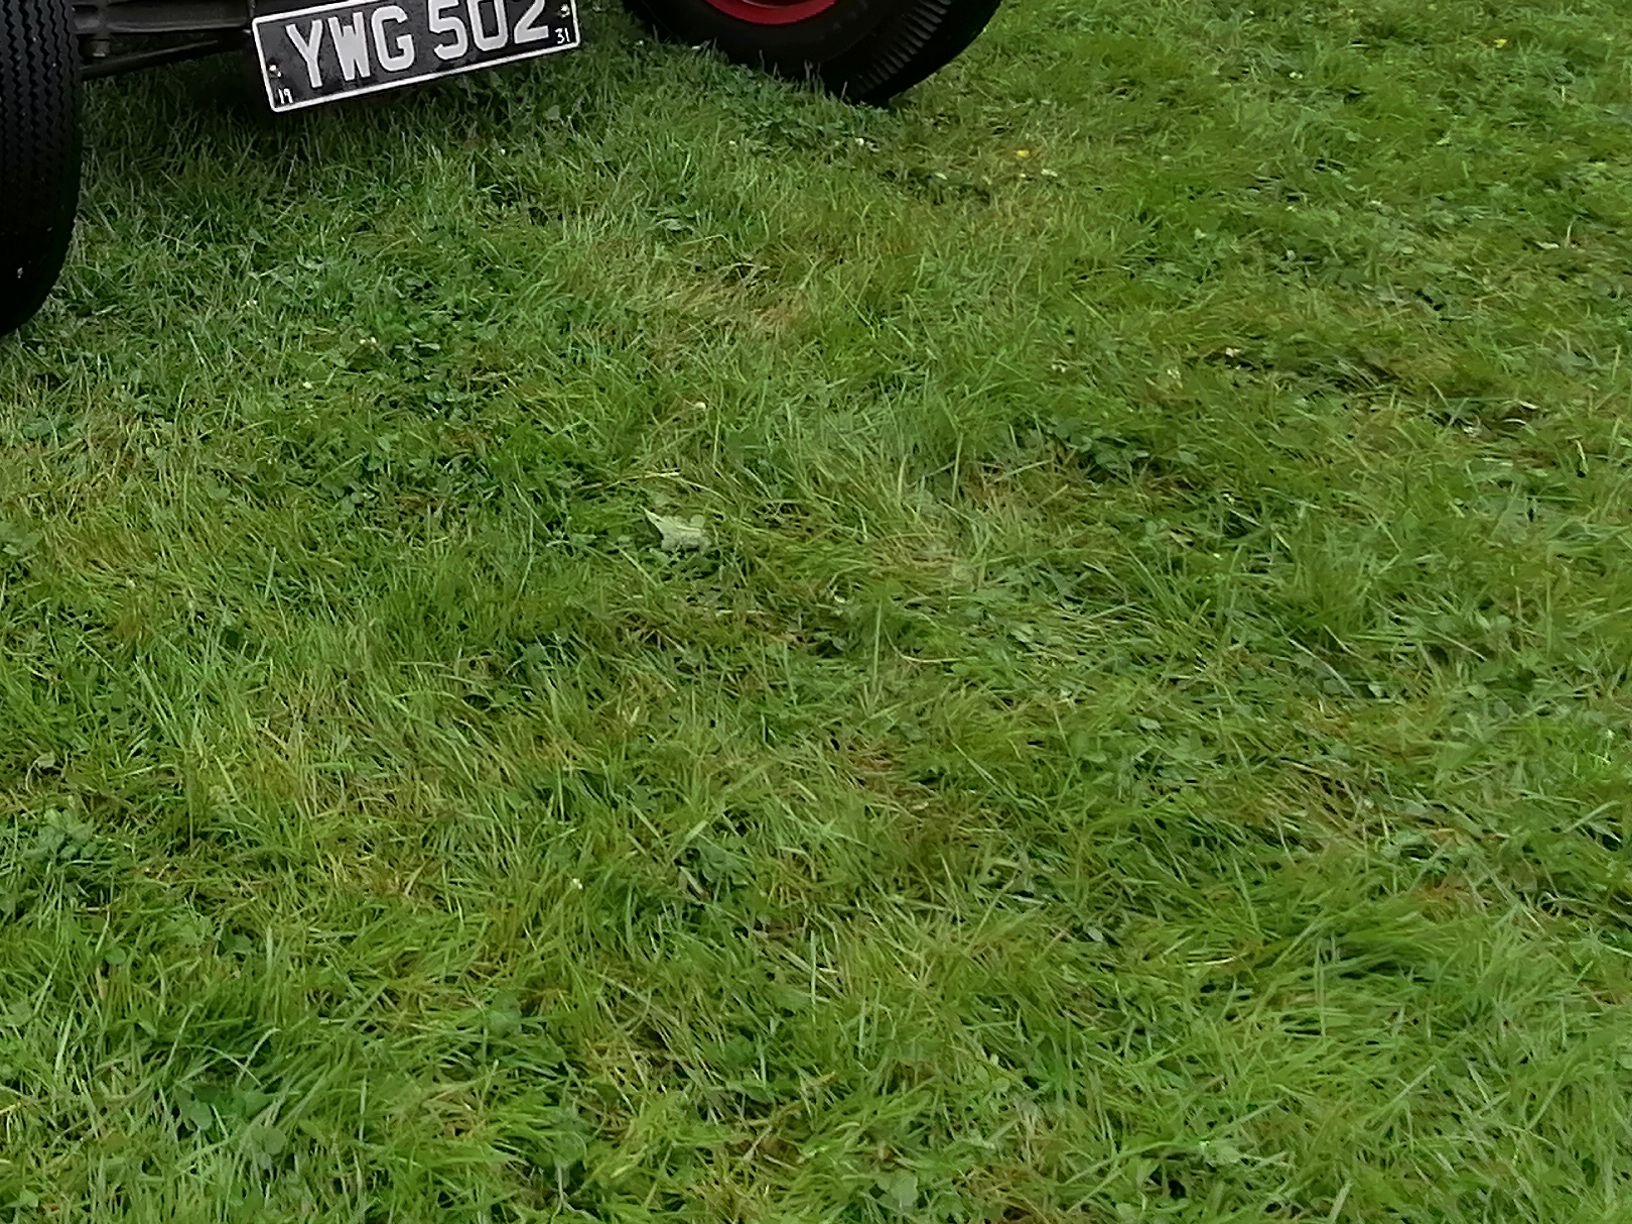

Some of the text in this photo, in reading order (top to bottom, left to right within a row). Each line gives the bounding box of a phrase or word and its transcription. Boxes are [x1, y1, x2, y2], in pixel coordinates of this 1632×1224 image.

[554, 27, 571, 45] 31
[285, 5, 415, 88] YWG
[277, 88, 293, 105] 19
